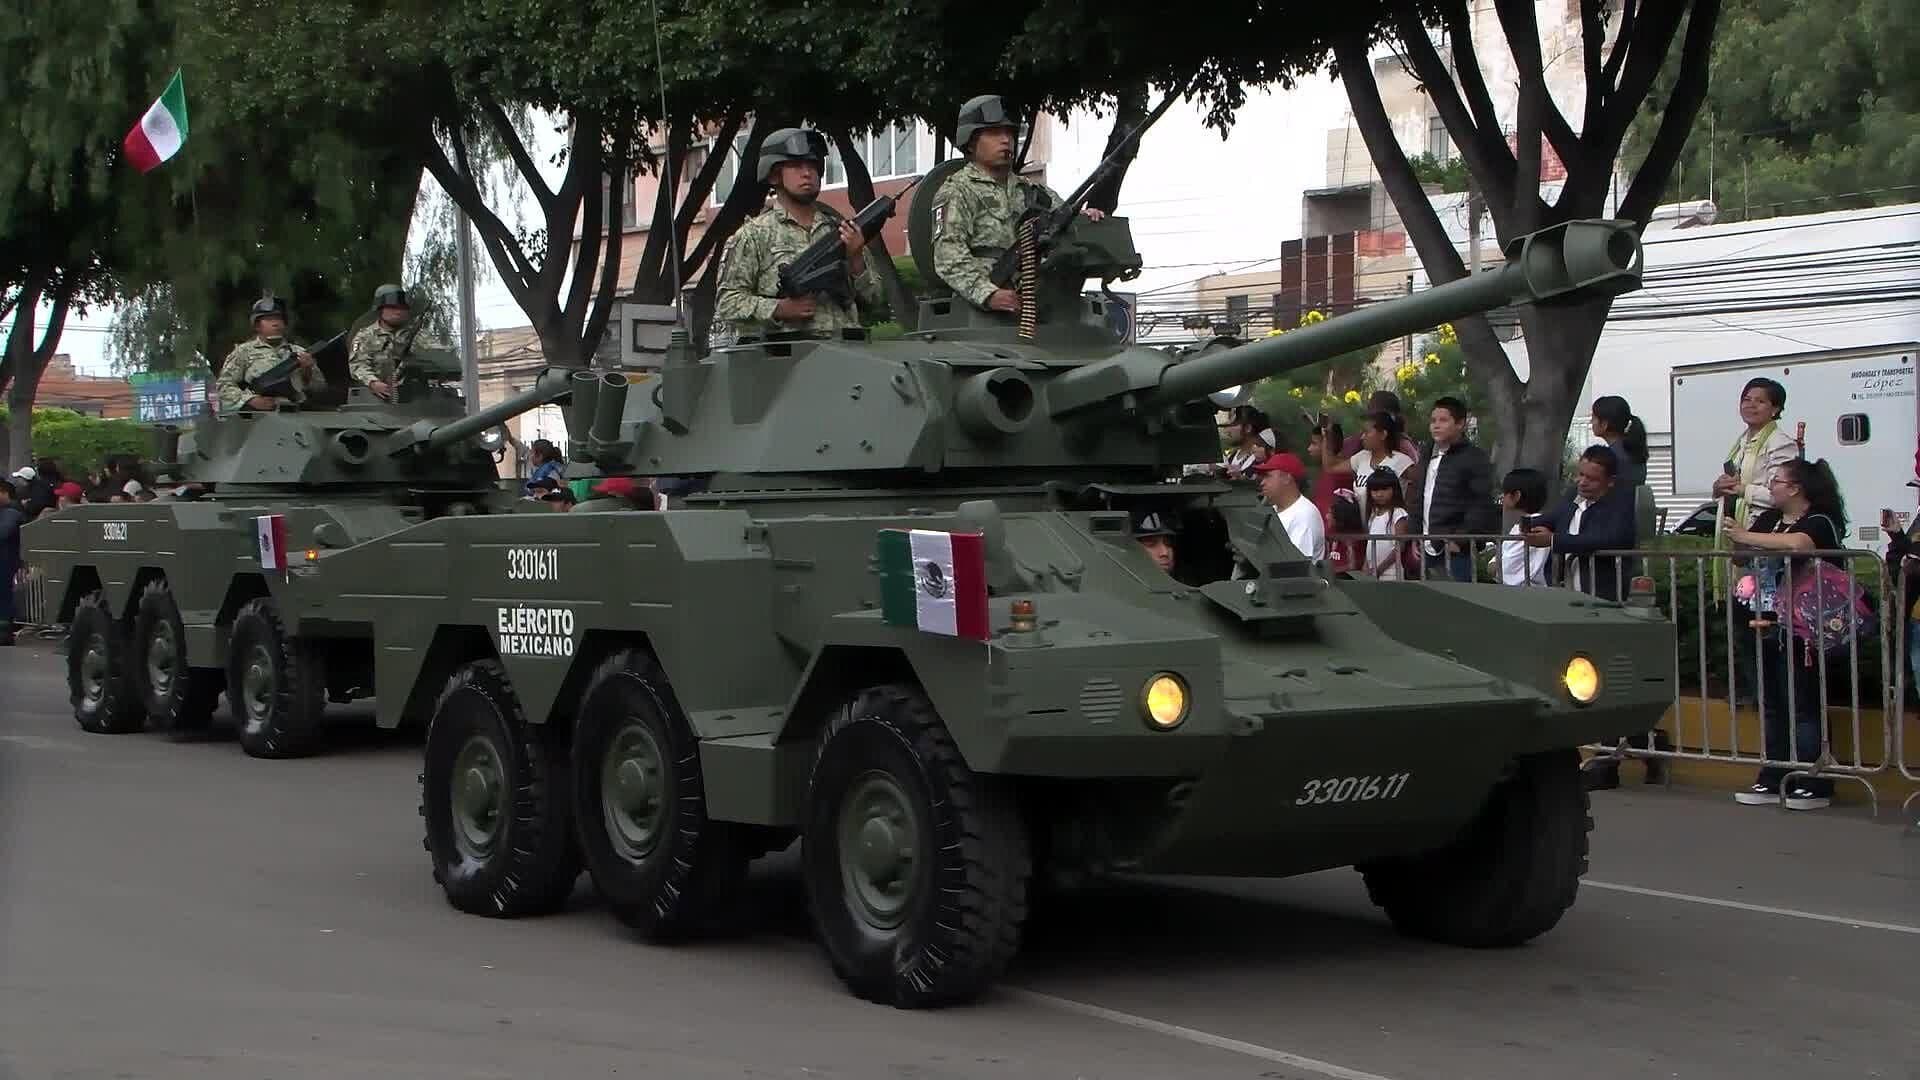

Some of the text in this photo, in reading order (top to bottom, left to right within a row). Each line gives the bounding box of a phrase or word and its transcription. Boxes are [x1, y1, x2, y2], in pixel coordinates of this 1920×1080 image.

[1864, 379, 1903, 391] López
[508, 549, 558, 580] 3301611
[498, 603, 574, 635] EJÉRCITO
[500, 635, 574, 656] MEXICANO
[1295, 773, 1410, 805] 3301611
